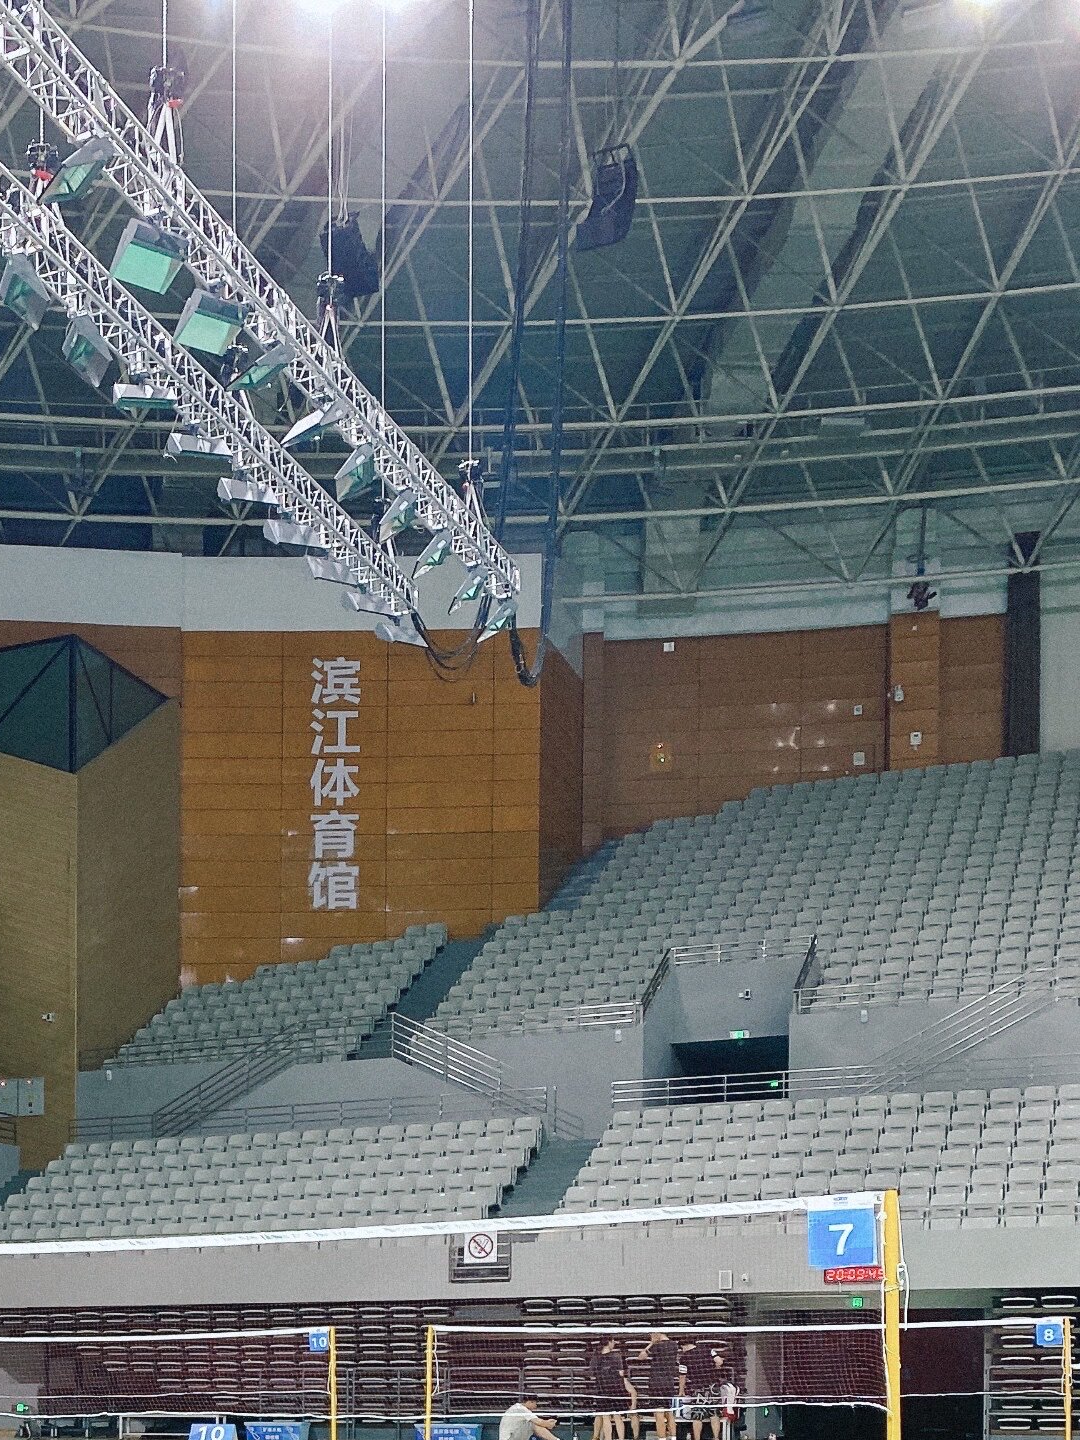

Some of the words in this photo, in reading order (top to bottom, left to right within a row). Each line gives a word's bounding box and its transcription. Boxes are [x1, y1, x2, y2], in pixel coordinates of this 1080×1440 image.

[308, 657, 361, 910] 滨江体育馆
[828, 1223, 854, 1256] 7
[311, 1336, 327, 1349] 10
[1043, 1328, 1055, 1342] 8
